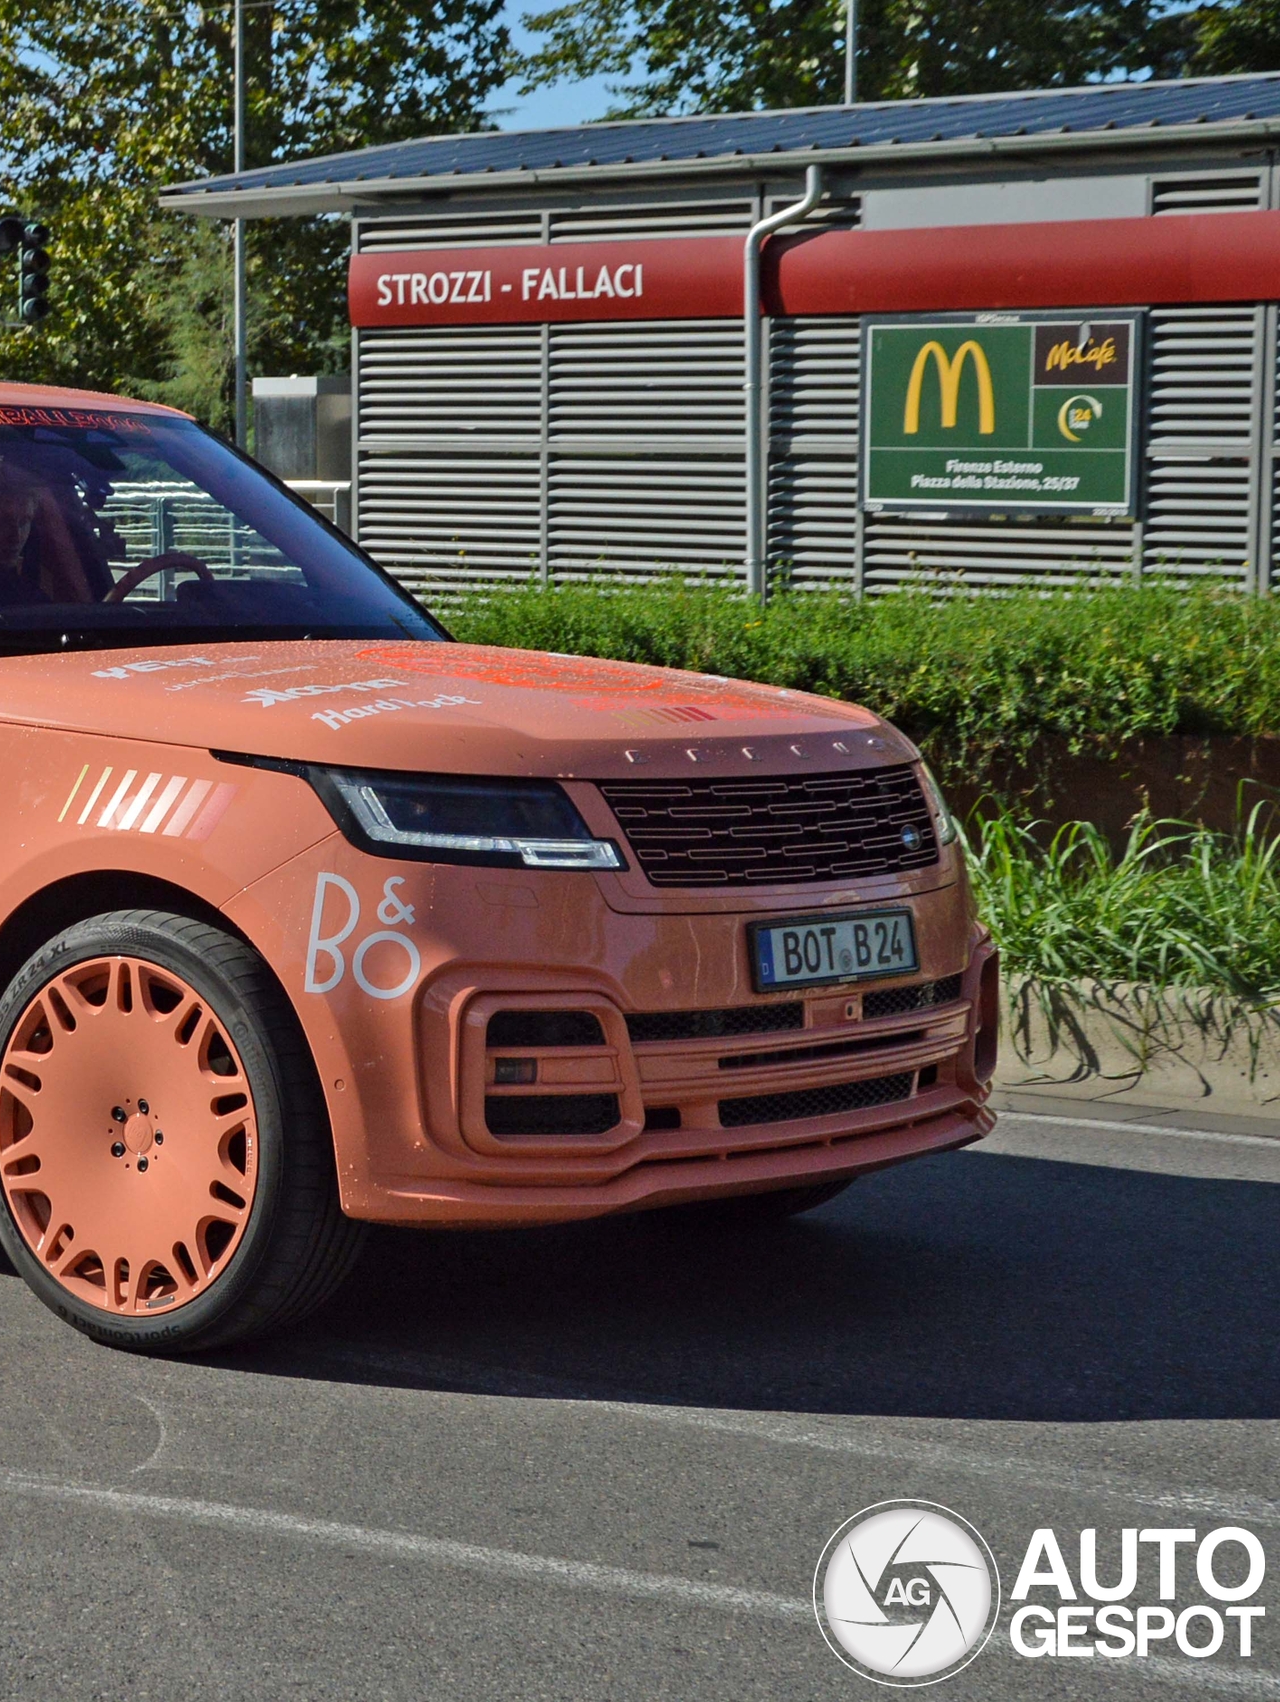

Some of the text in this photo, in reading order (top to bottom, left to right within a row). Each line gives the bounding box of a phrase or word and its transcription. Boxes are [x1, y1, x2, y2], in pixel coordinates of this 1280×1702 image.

[376, 270, 491, 306] STROZZI
[521, 264, 643, 301] FALLACI
[945, 459, 1043, 474] Firenze Esterno
[911, 475, 951, 488] Piazza
[952, 475, 983, 488] della
[310, 699, 401, 731] Hard
[50, 941, 72, 958] XL
[782, 927, 837, 976] BOT
